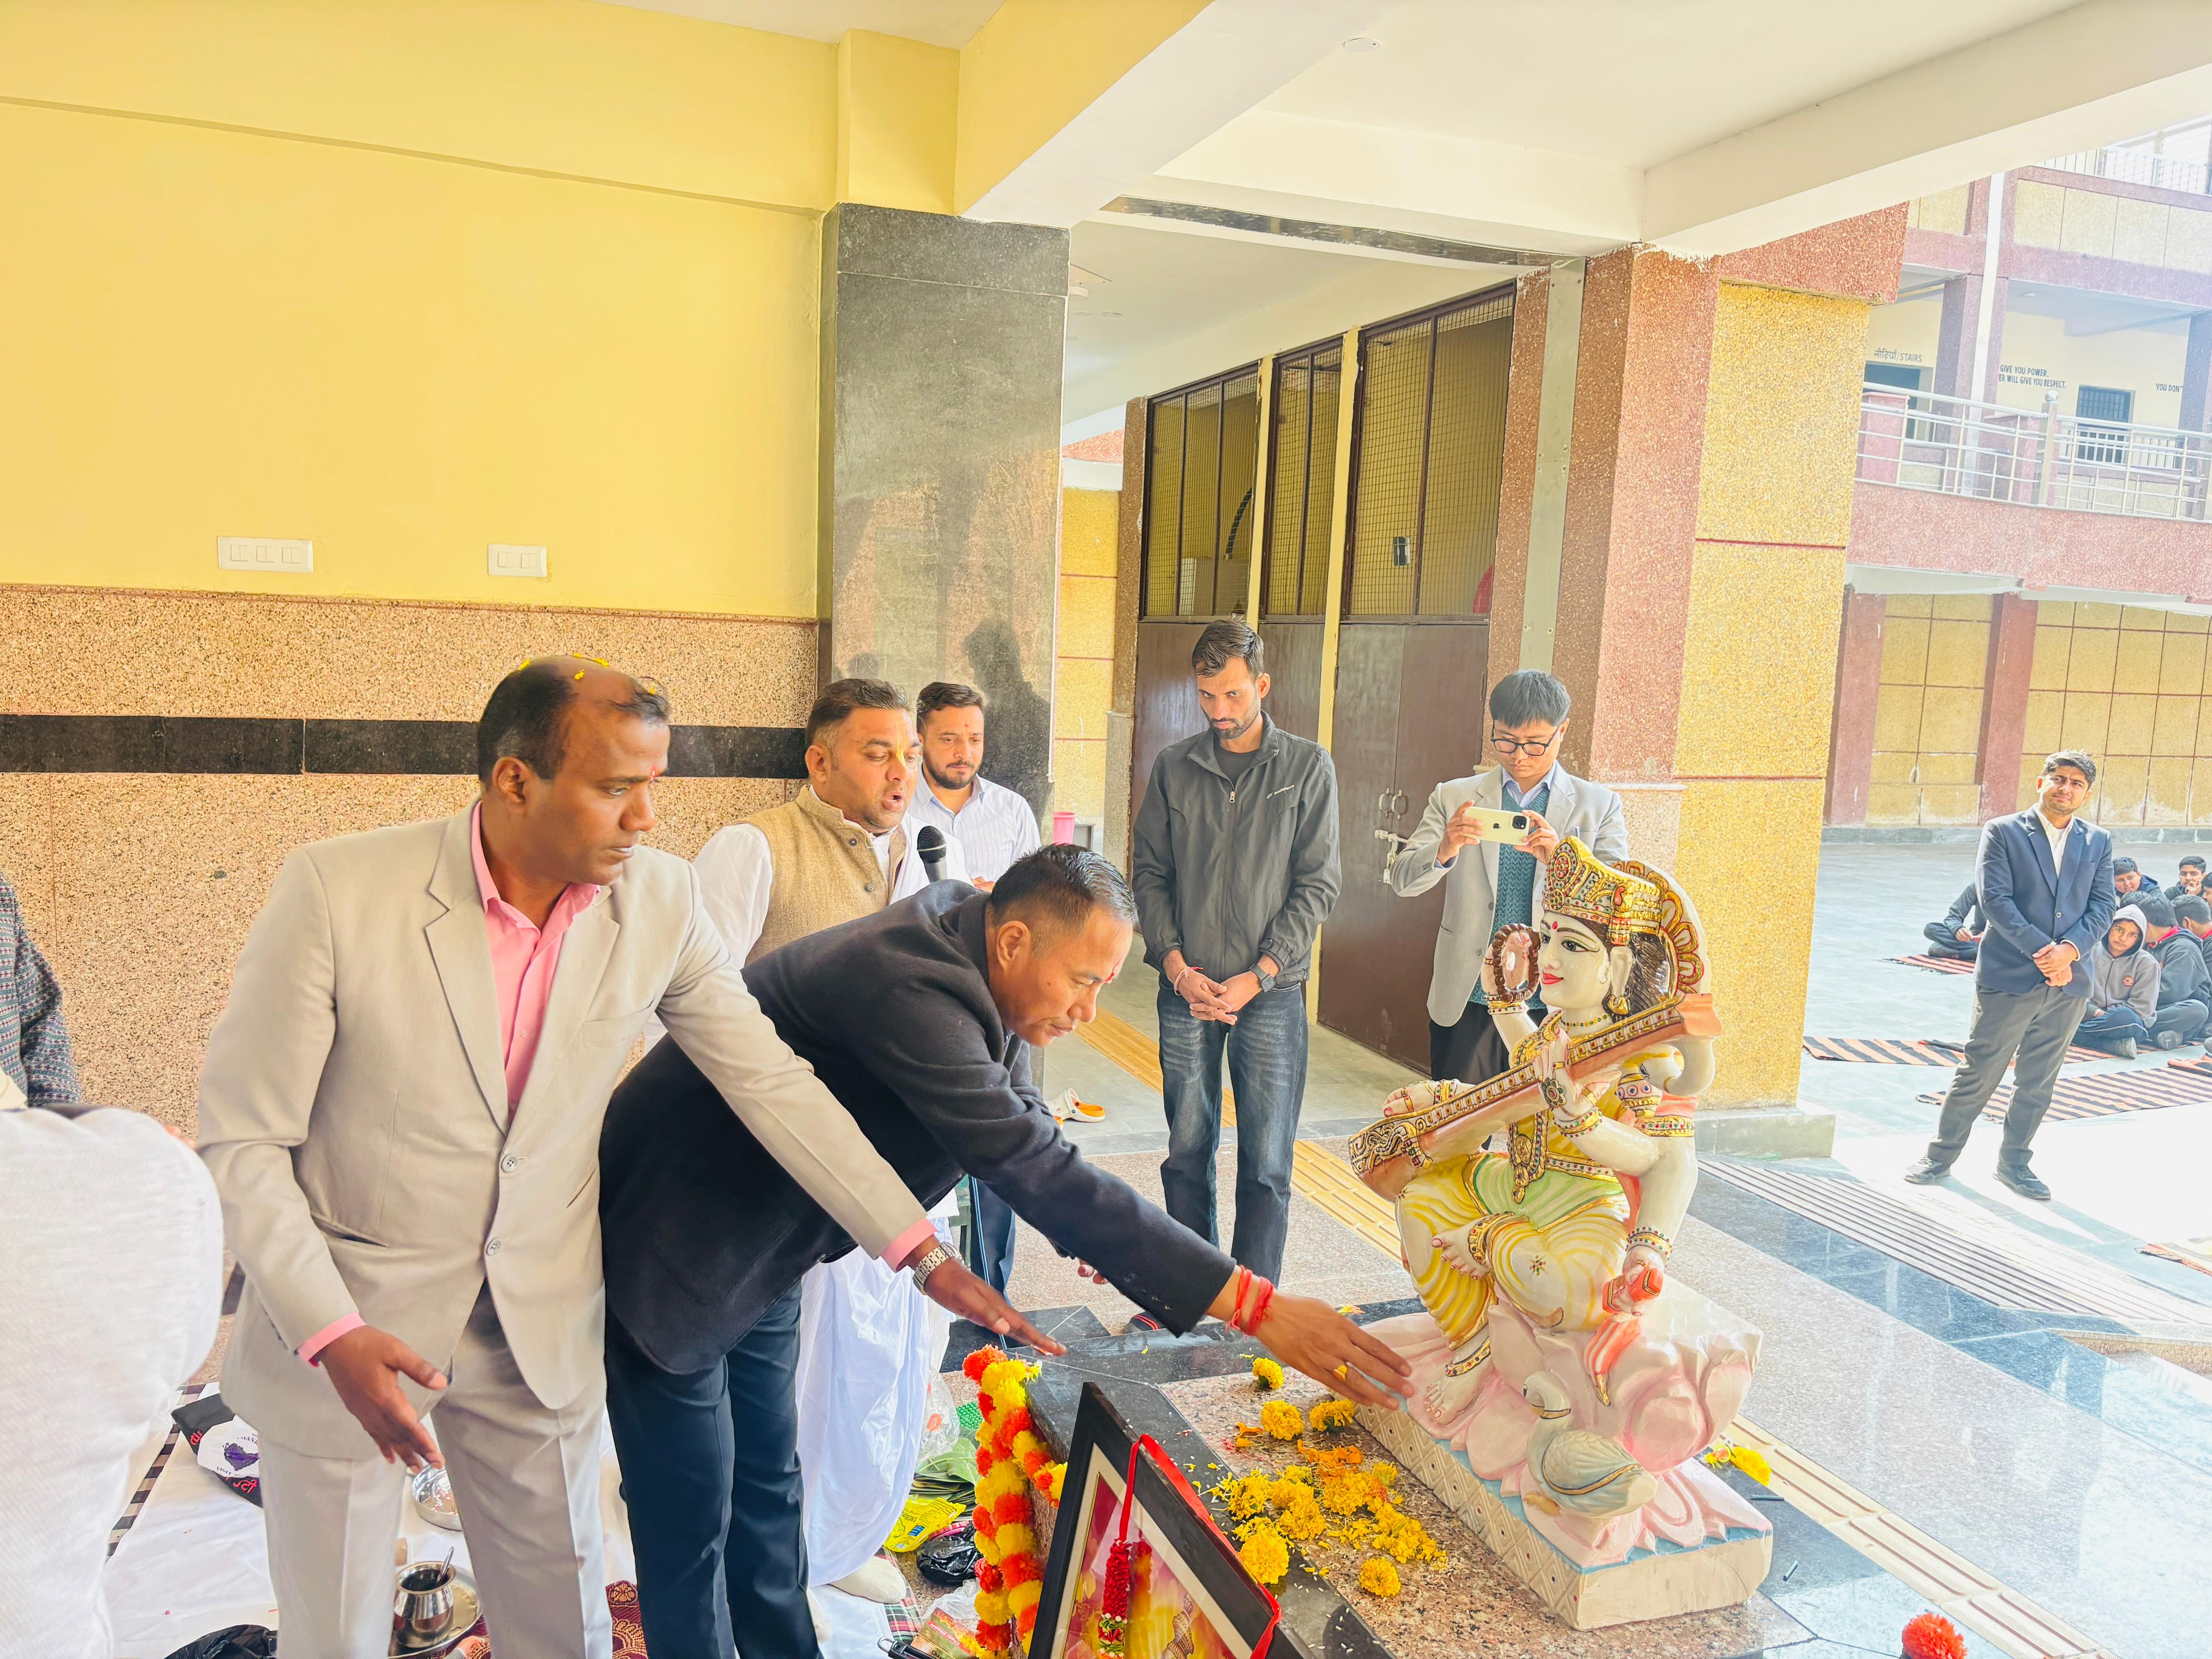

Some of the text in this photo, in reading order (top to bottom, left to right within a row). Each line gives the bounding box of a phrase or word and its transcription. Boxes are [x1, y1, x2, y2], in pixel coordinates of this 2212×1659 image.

[2000, 364, 2049, 378] GIVE YOU POWER.
[2007, 375, 2018, 383] WILL
[2020, 376, 2032, 385] GIVE
[2033, 378, 2043, 386] YOU
[2043, 379, 2066, 388] RESPECT.
